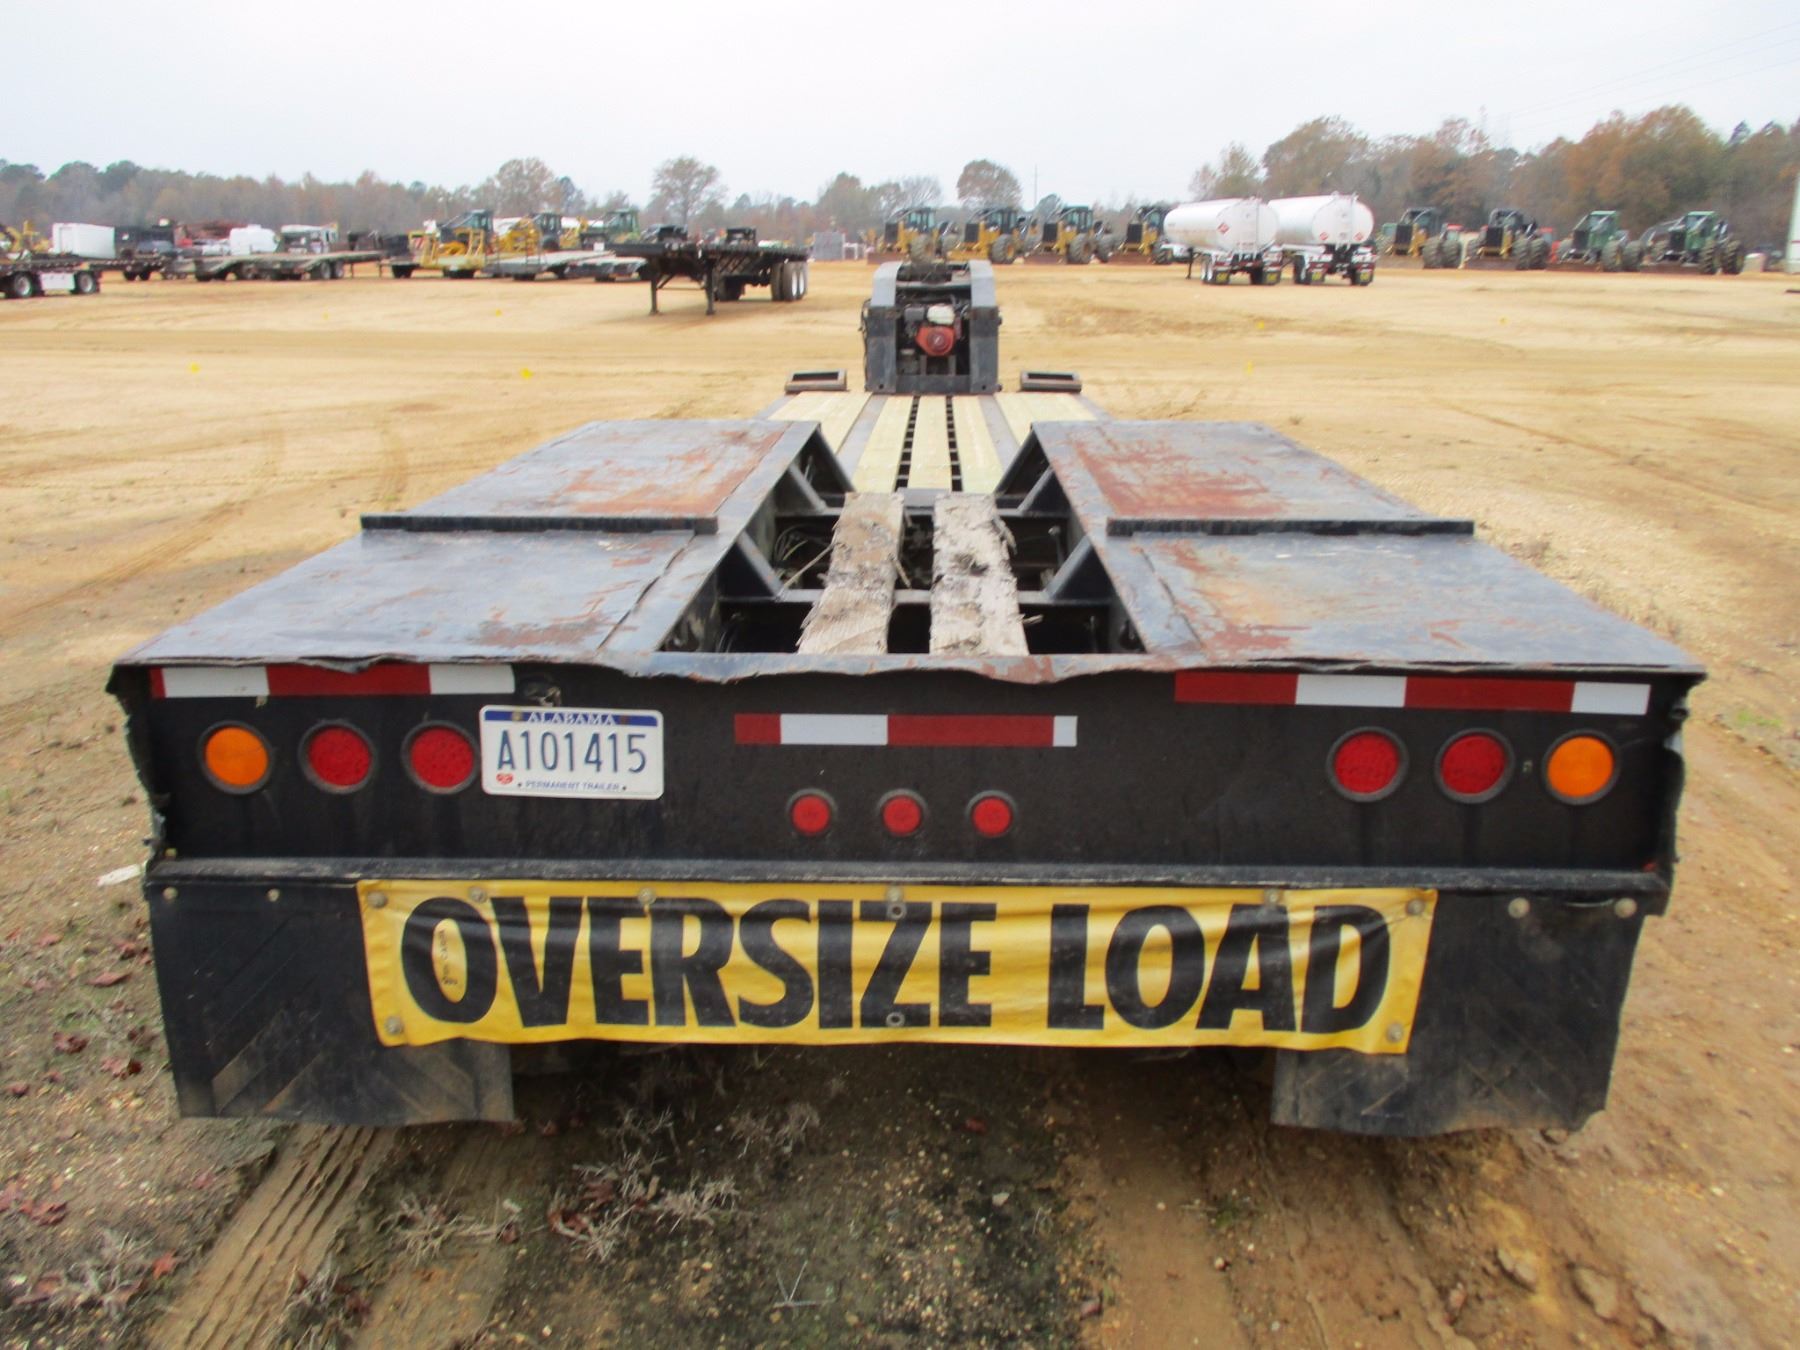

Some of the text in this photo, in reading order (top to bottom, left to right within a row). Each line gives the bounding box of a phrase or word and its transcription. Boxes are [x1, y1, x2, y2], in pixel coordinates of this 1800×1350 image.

[527, 711, 617, 726] ALABAMA
[497, 729, 647, 774] A101415
[524, 779, 621, 792] PERMANENT TRAILER
[400, 896, 998, 1029] OVERSIZE
[1046, 903, 1391, 1034] LOAD
